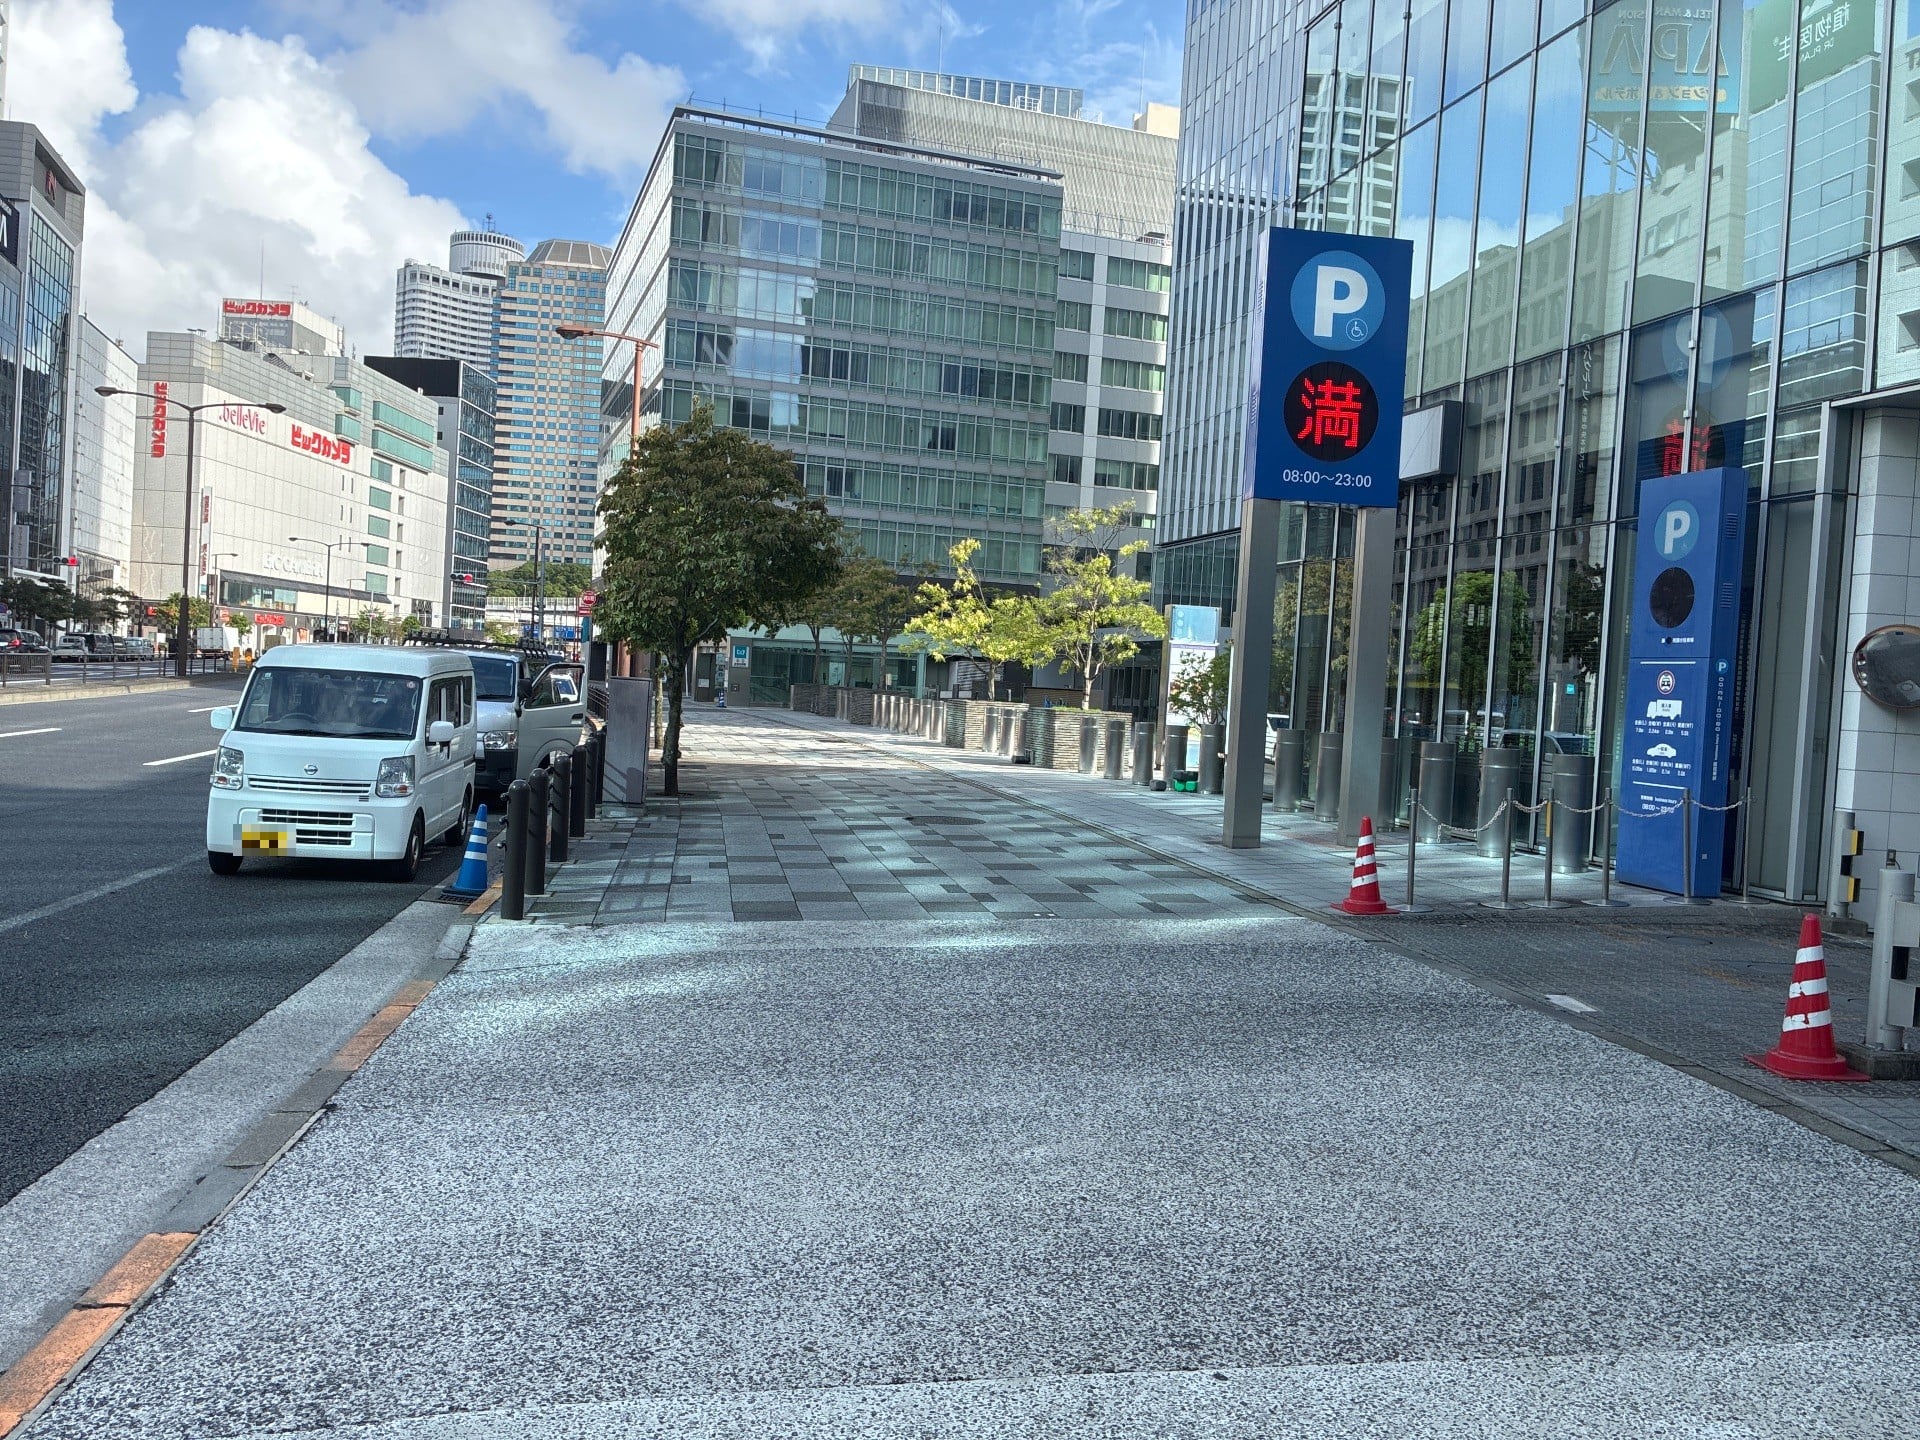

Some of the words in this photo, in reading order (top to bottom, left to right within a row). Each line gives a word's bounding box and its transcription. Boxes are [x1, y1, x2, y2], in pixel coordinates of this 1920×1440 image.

[224, 301, 292, 317] ビックカメラ
[1314, 265, 1368, 338] P
[151, 382, 168, 459] ビックカメラ
[1297, 377, 1362, 448] 満
[291, 424, 351, 465] ビックカメラ
[1664, 510, 1691, 554] P
